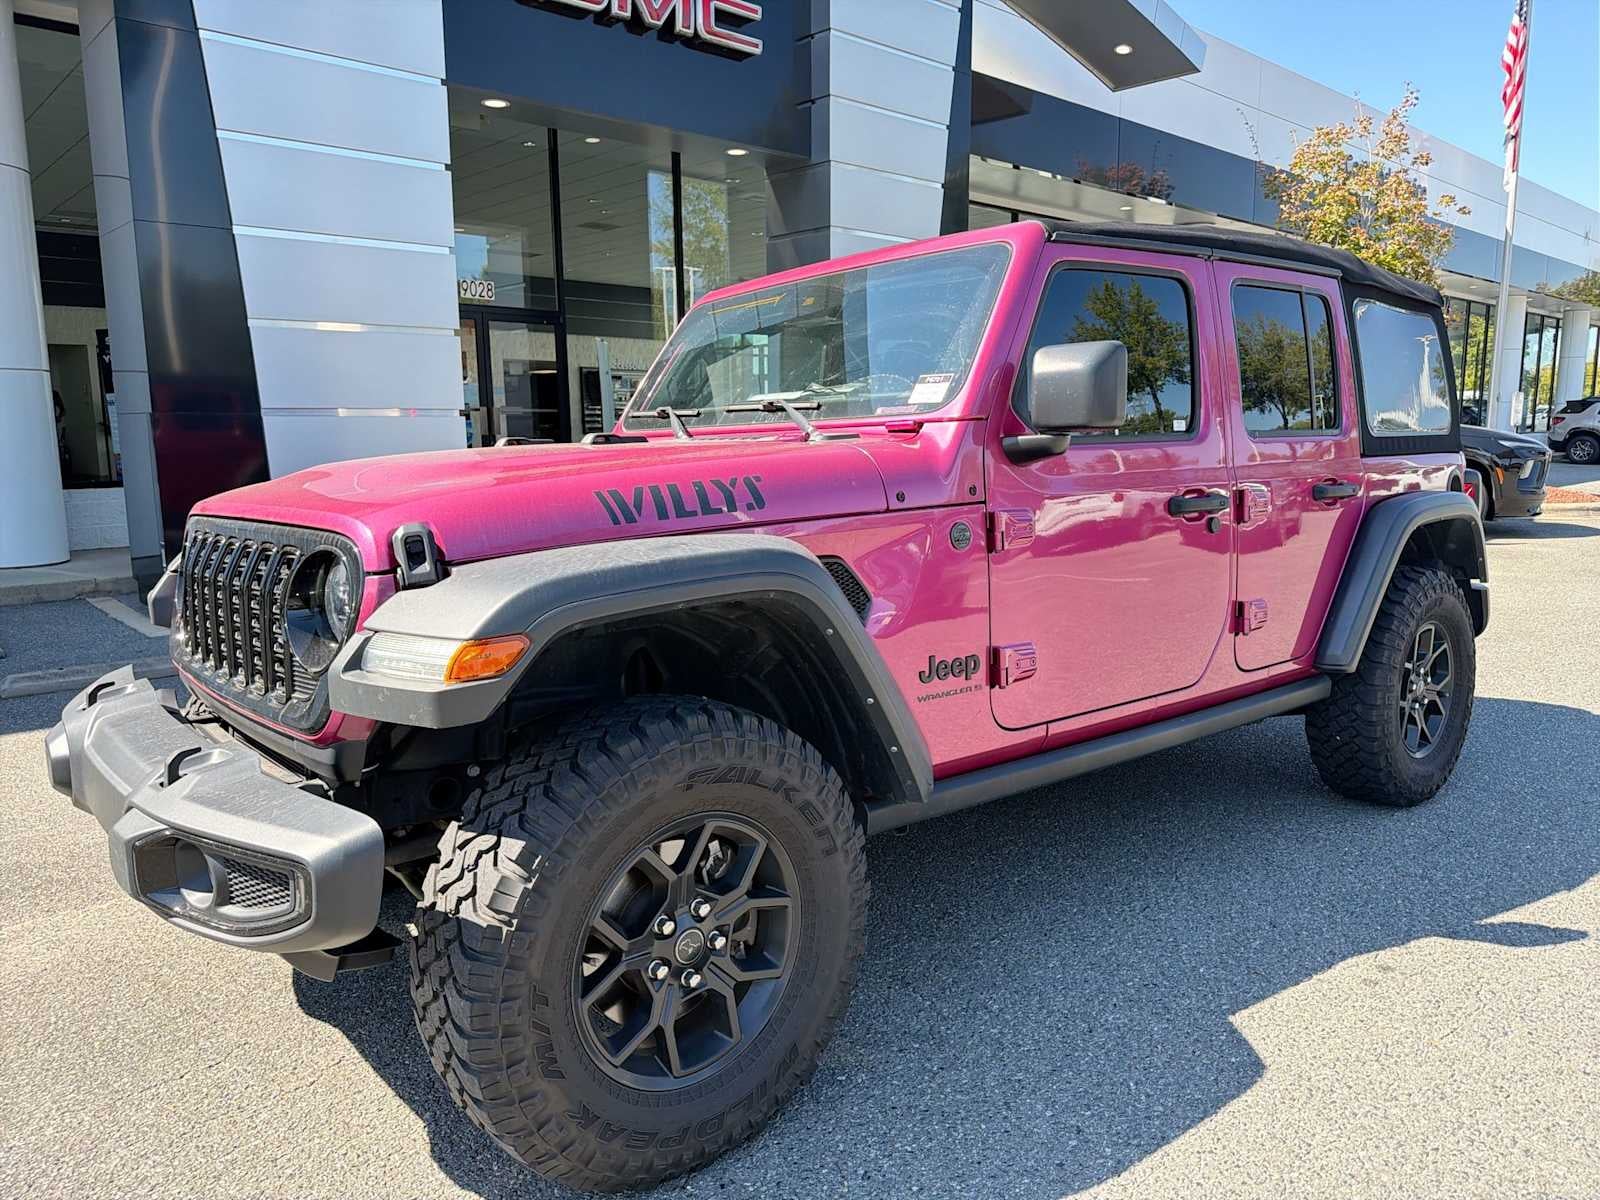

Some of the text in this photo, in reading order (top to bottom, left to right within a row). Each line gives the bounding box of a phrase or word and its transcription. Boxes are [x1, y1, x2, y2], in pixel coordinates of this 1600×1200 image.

[513, 0, 763, 55] MC
[461, 280, 494, 299] 9028
[593, 475, 766, 525] WILLYS
[918, 654, 981, 684] Jeep
[916, 685, 973, 703] WRANGLER
